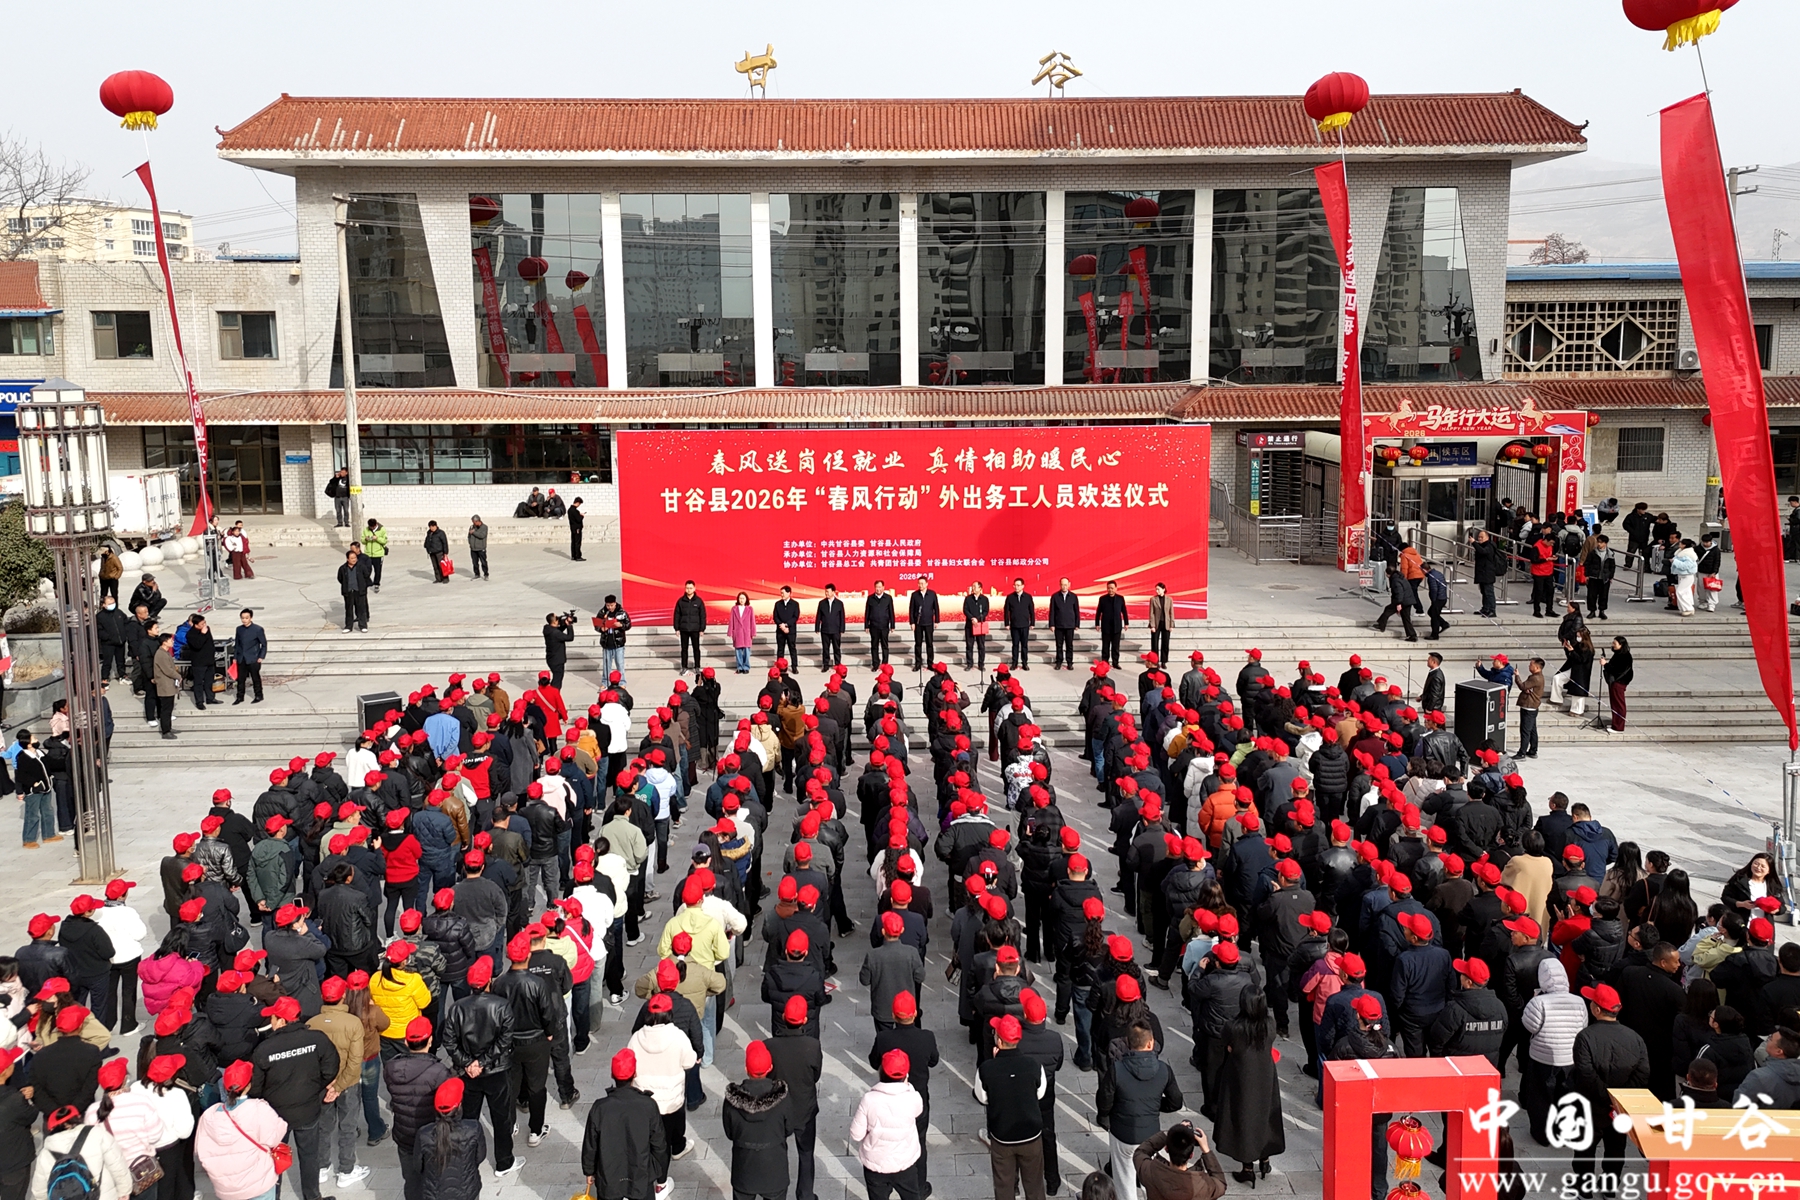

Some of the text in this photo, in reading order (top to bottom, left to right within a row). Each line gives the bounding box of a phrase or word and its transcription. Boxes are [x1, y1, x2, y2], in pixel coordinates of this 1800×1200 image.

[1419, 405, 1516, 431] 马年行大运
[707, 446, 1122, 475] 春风送岗促就业 真情相助暖民心
[1442, 447, 1470, 456] 候车区
